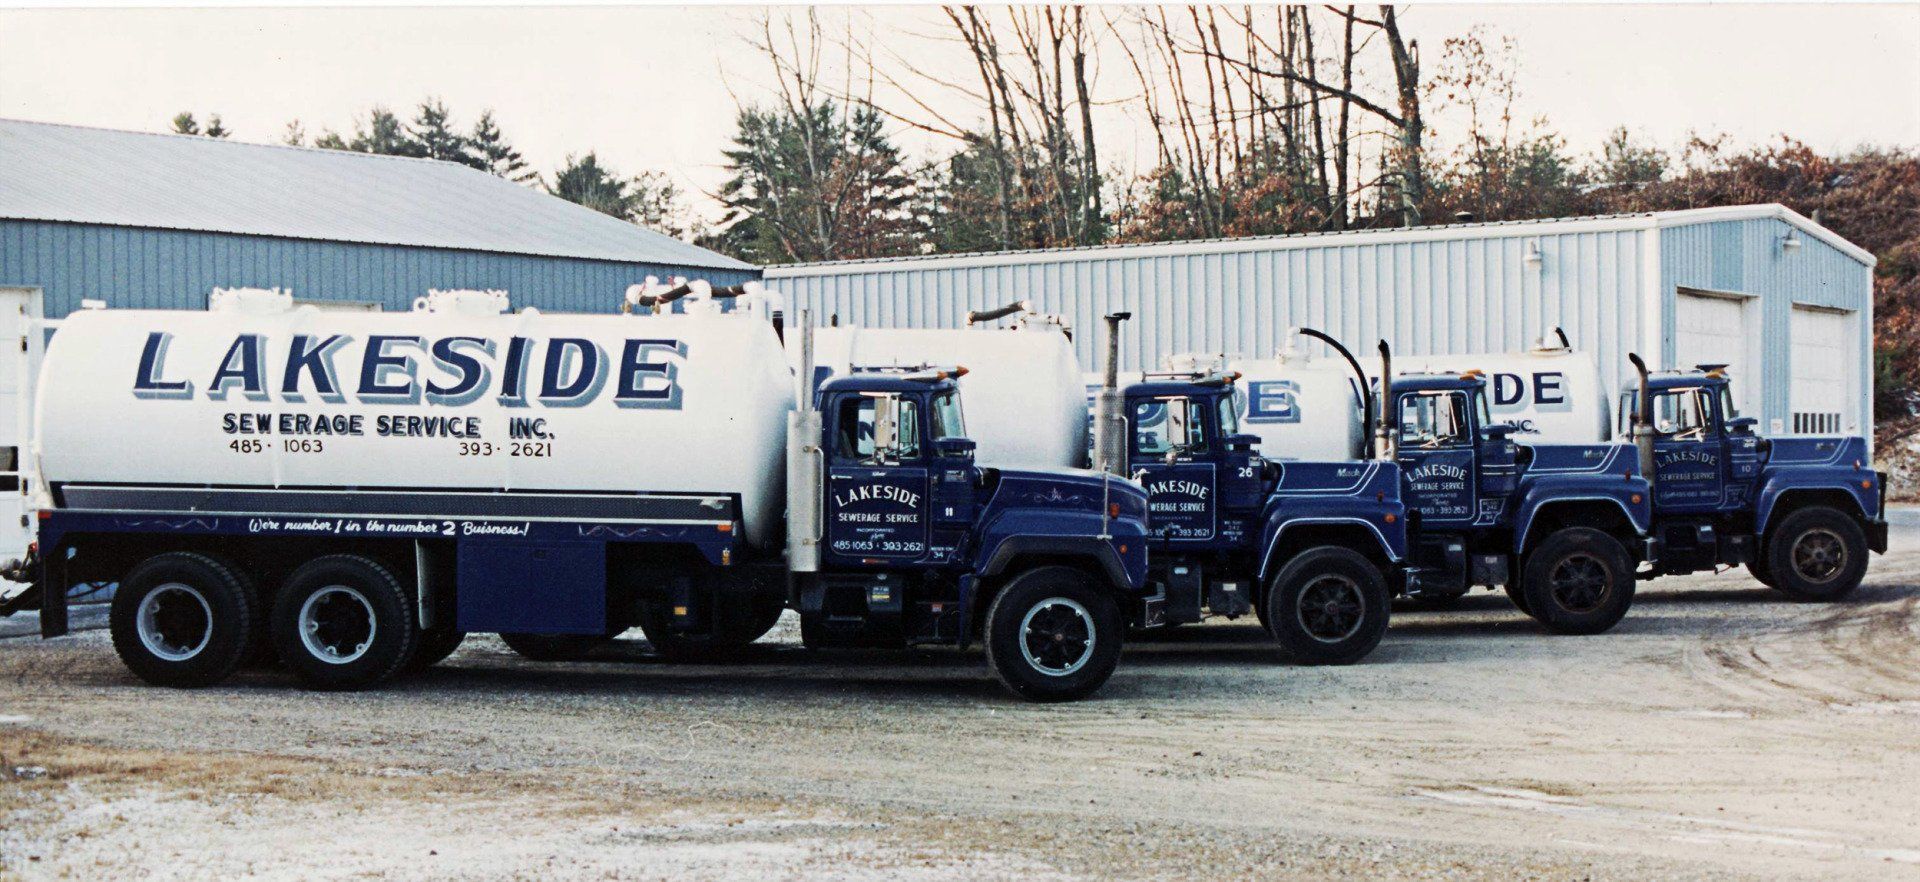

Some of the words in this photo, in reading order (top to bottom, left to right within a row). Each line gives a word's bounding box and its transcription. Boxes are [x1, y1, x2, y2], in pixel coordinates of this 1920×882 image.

[132, 332, 688, 410] LAKESIDE
[1493, 372, 1572, 412] DE
[376, 415, 481, 438] SERVICE
[509, 417, 555, 439] INC.
[284, 439, 323, 453] 1063
[510, 442, 552, 457] 2621
[1657, 450, 1717, 468] LAKESIDE
[1238, 467, 1253, 478] 26
[1405, 464, 1467, 482] LAKESIDE
[1149, 480, 1209, 500] AKESIDE
[1441, 482, 1464, 490] SERVICE
[835, 484, 920, 508] LAKESIDE
[945, 507, 953, 516] 11
[1150, 503, 1177, 512] WERAGE
[1180, 503, 1205, 512] SERVICE
[839, 512, 880, 522] SEWERAGE
[886, 513, 918, 523] SERVICE
[284, 519, 332, 531] number
[345, 520, 361, 532] in
[366, 520, 384, 532] the
[387, 521, 437, 532] number
[442, 521, 456, 536] 2
[833, 541, 851, 551] 485
[852, 541, 873, 551] 1063
[882, 542, 902, 551] 393
[903, 542, 924, 551] 2621
